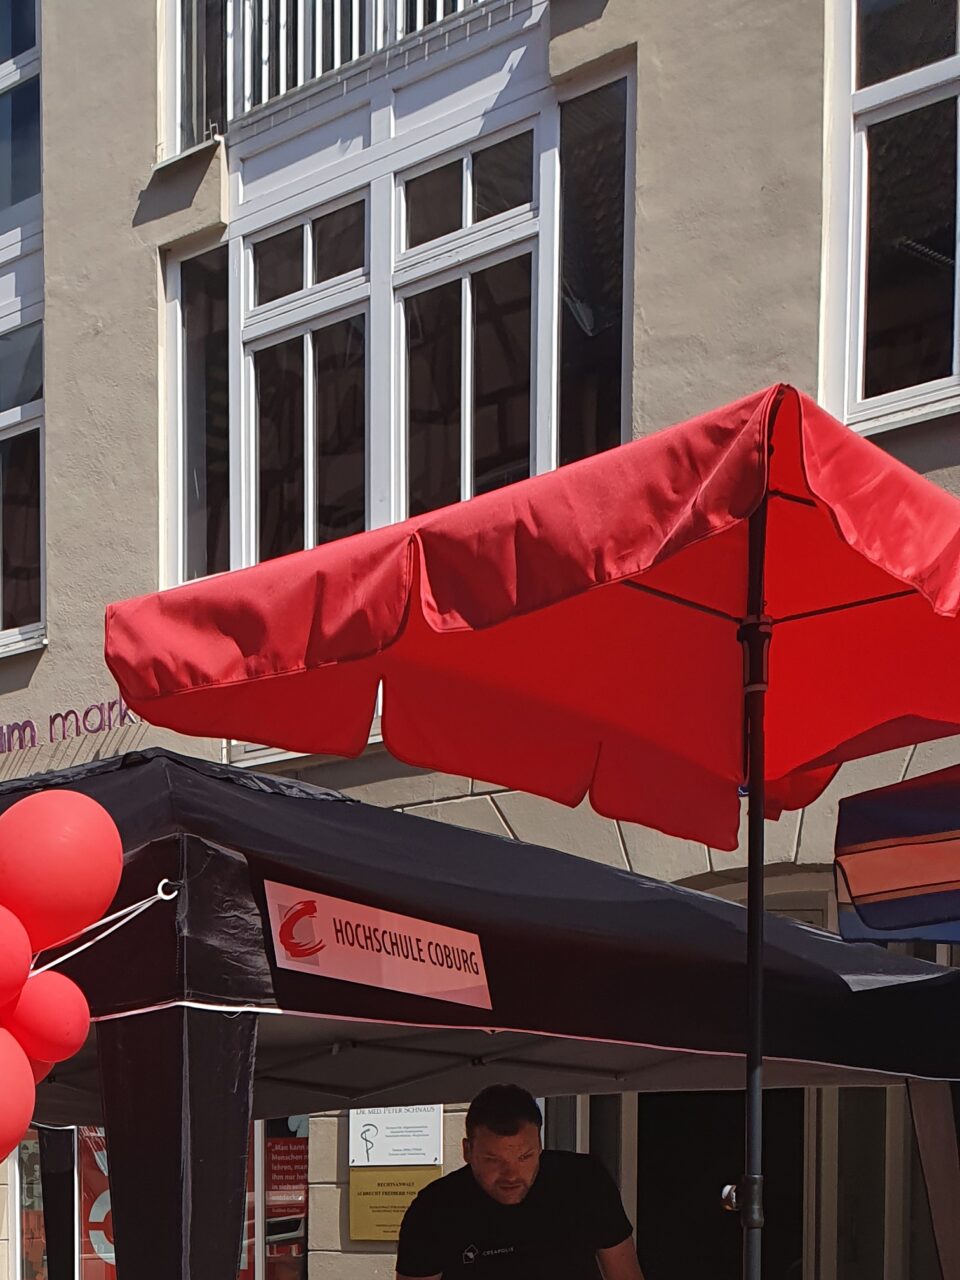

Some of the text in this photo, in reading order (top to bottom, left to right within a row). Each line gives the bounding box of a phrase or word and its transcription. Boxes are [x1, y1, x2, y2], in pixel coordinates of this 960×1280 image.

[49, 694, 143, 743] mark
[333, 917, 480, 976] HOCHSCHULE COBURG
